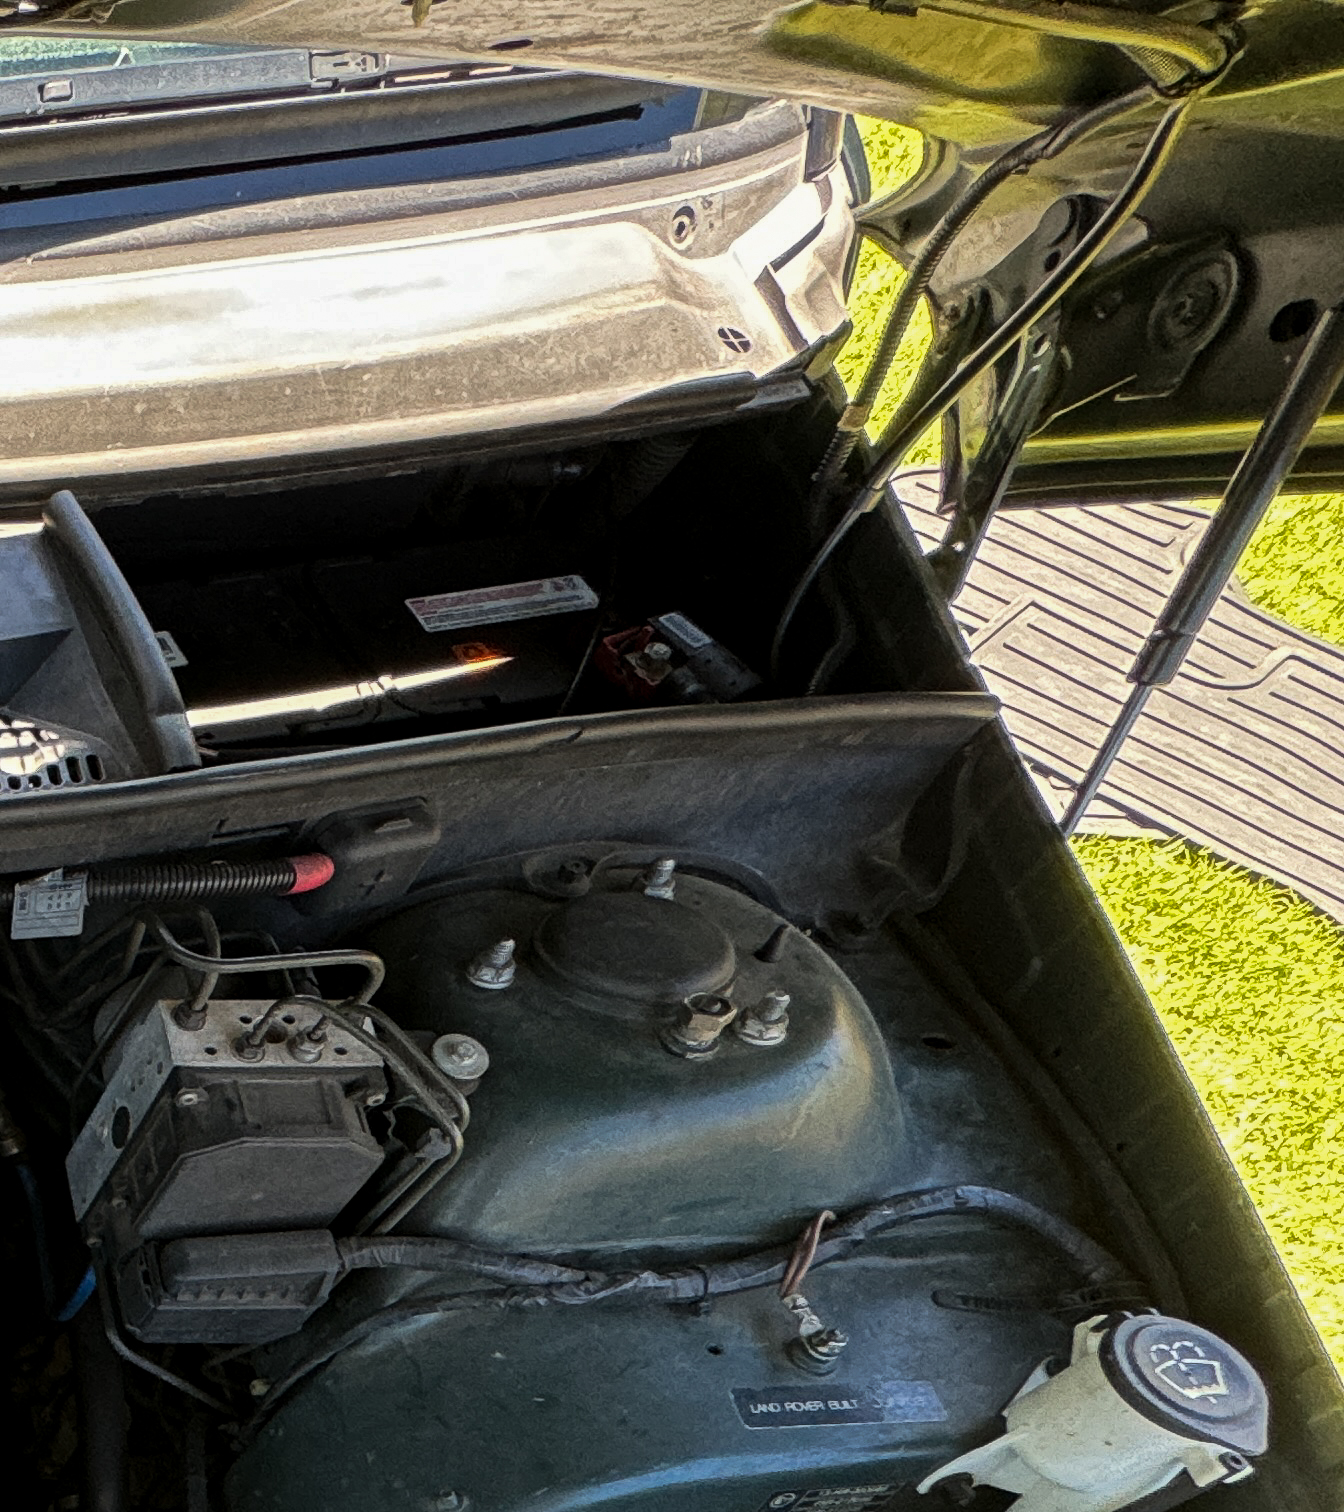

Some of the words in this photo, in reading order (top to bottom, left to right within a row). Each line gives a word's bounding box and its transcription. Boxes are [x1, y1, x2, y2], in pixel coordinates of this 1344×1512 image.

[750, 1402, 780, 1414] LAND
[785, 1400, 825, 1412] ROVER
[829, 1399, 858, 1411] BUILT
